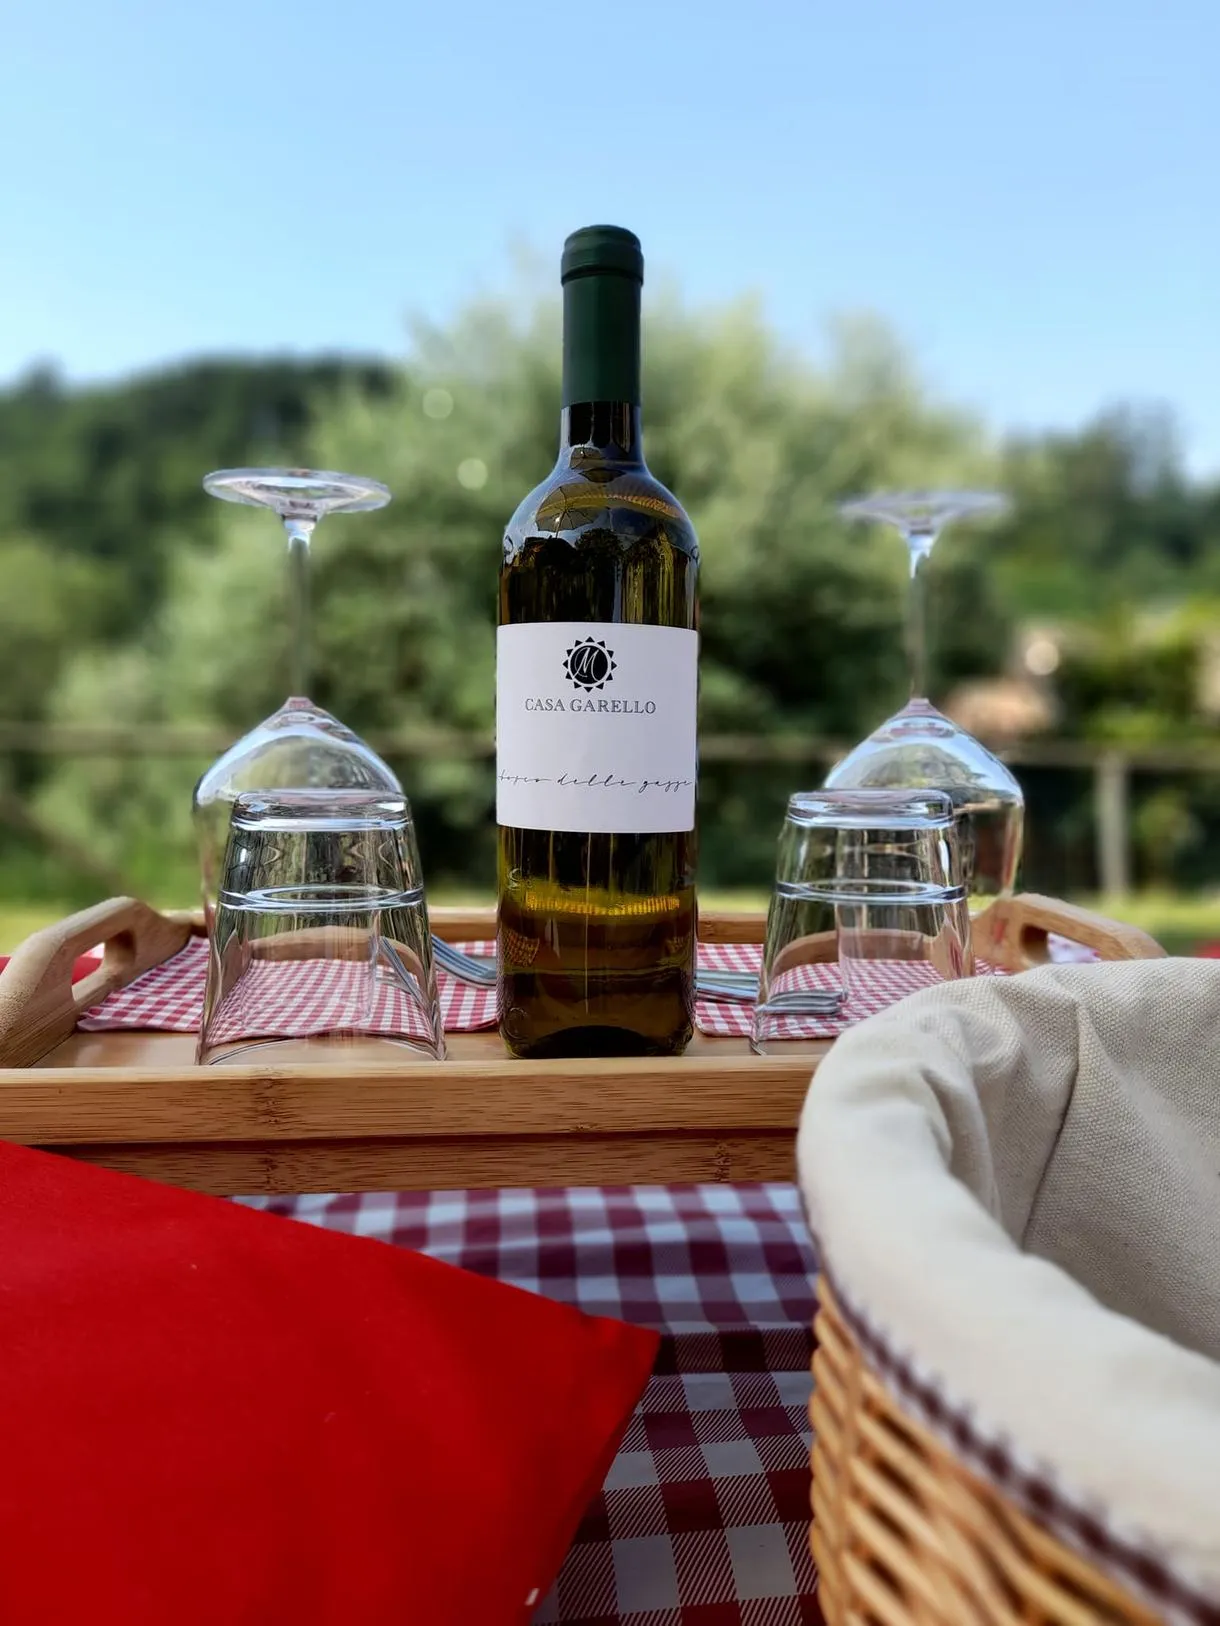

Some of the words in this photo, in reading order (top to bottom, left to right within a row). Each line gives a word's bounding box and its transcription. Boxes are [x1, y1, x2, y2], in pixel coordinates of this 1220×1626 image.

[525, 698, 565, 712] CASA
[569, 699, 657, 714] GARELLO
[557, 773, 636, 786] delle
